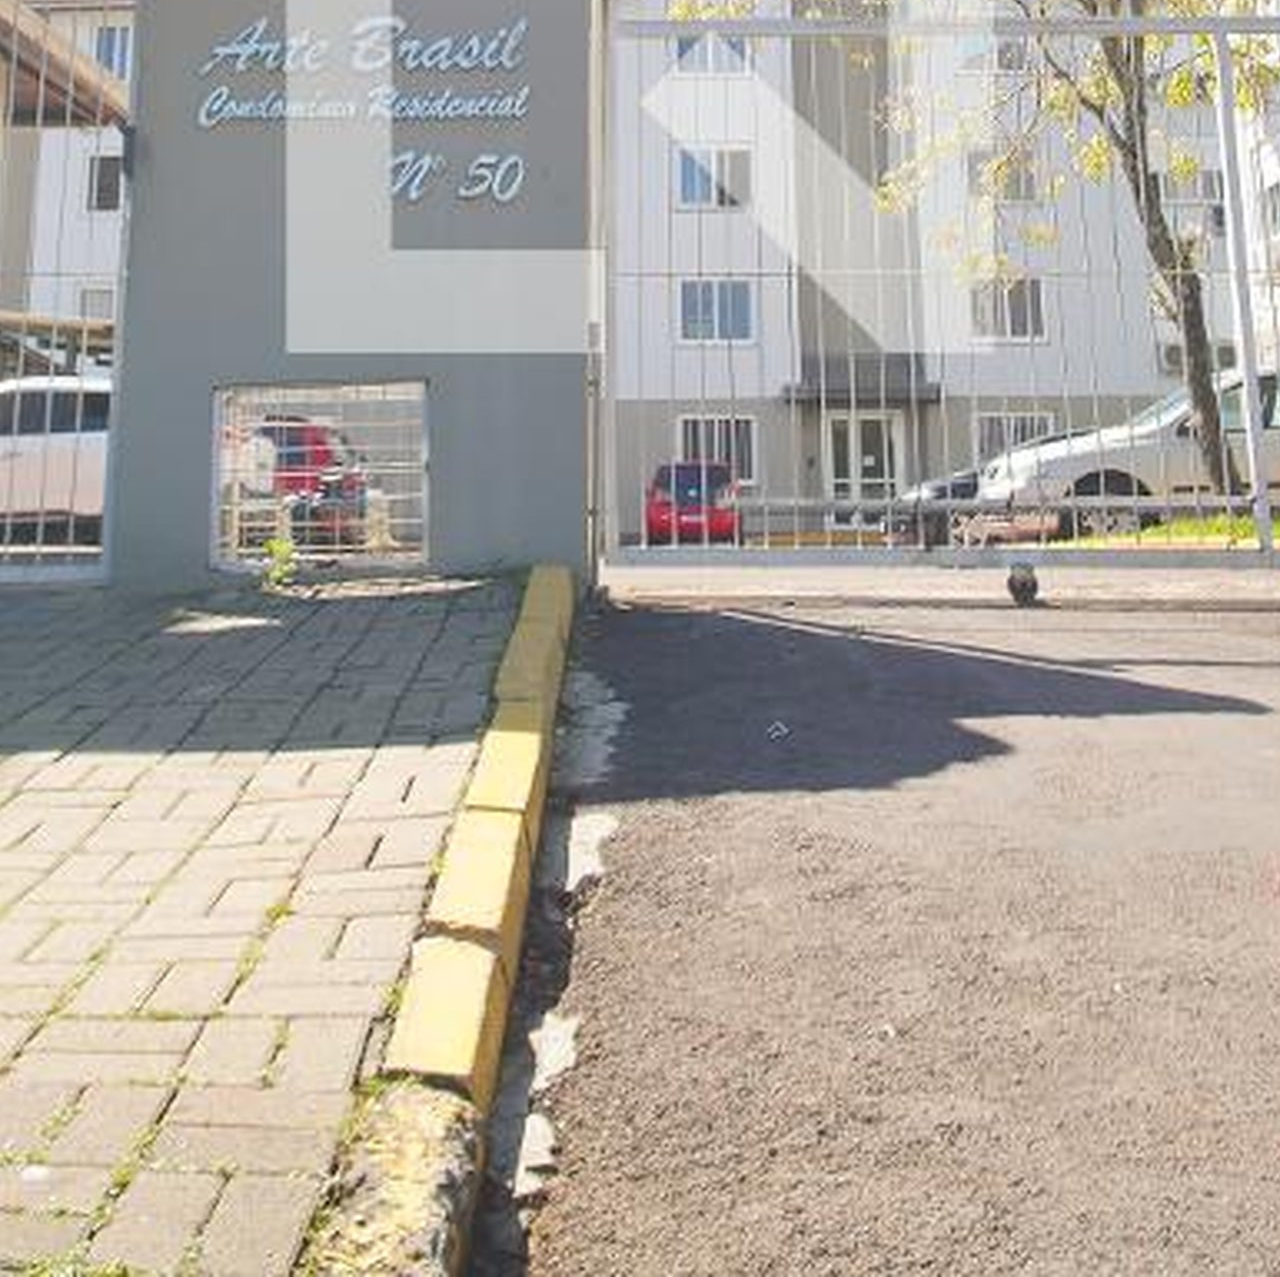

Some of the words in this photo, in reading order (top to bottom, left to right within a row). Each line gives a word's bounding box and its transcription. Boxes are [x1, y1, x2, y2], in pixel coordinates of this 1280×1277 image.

[200, 16, 329, 72] Arte
[350, 16, 527, 71] Brasil
[368, 85, 529, 121] Residencial
[458, 154, 524, 202] 50
